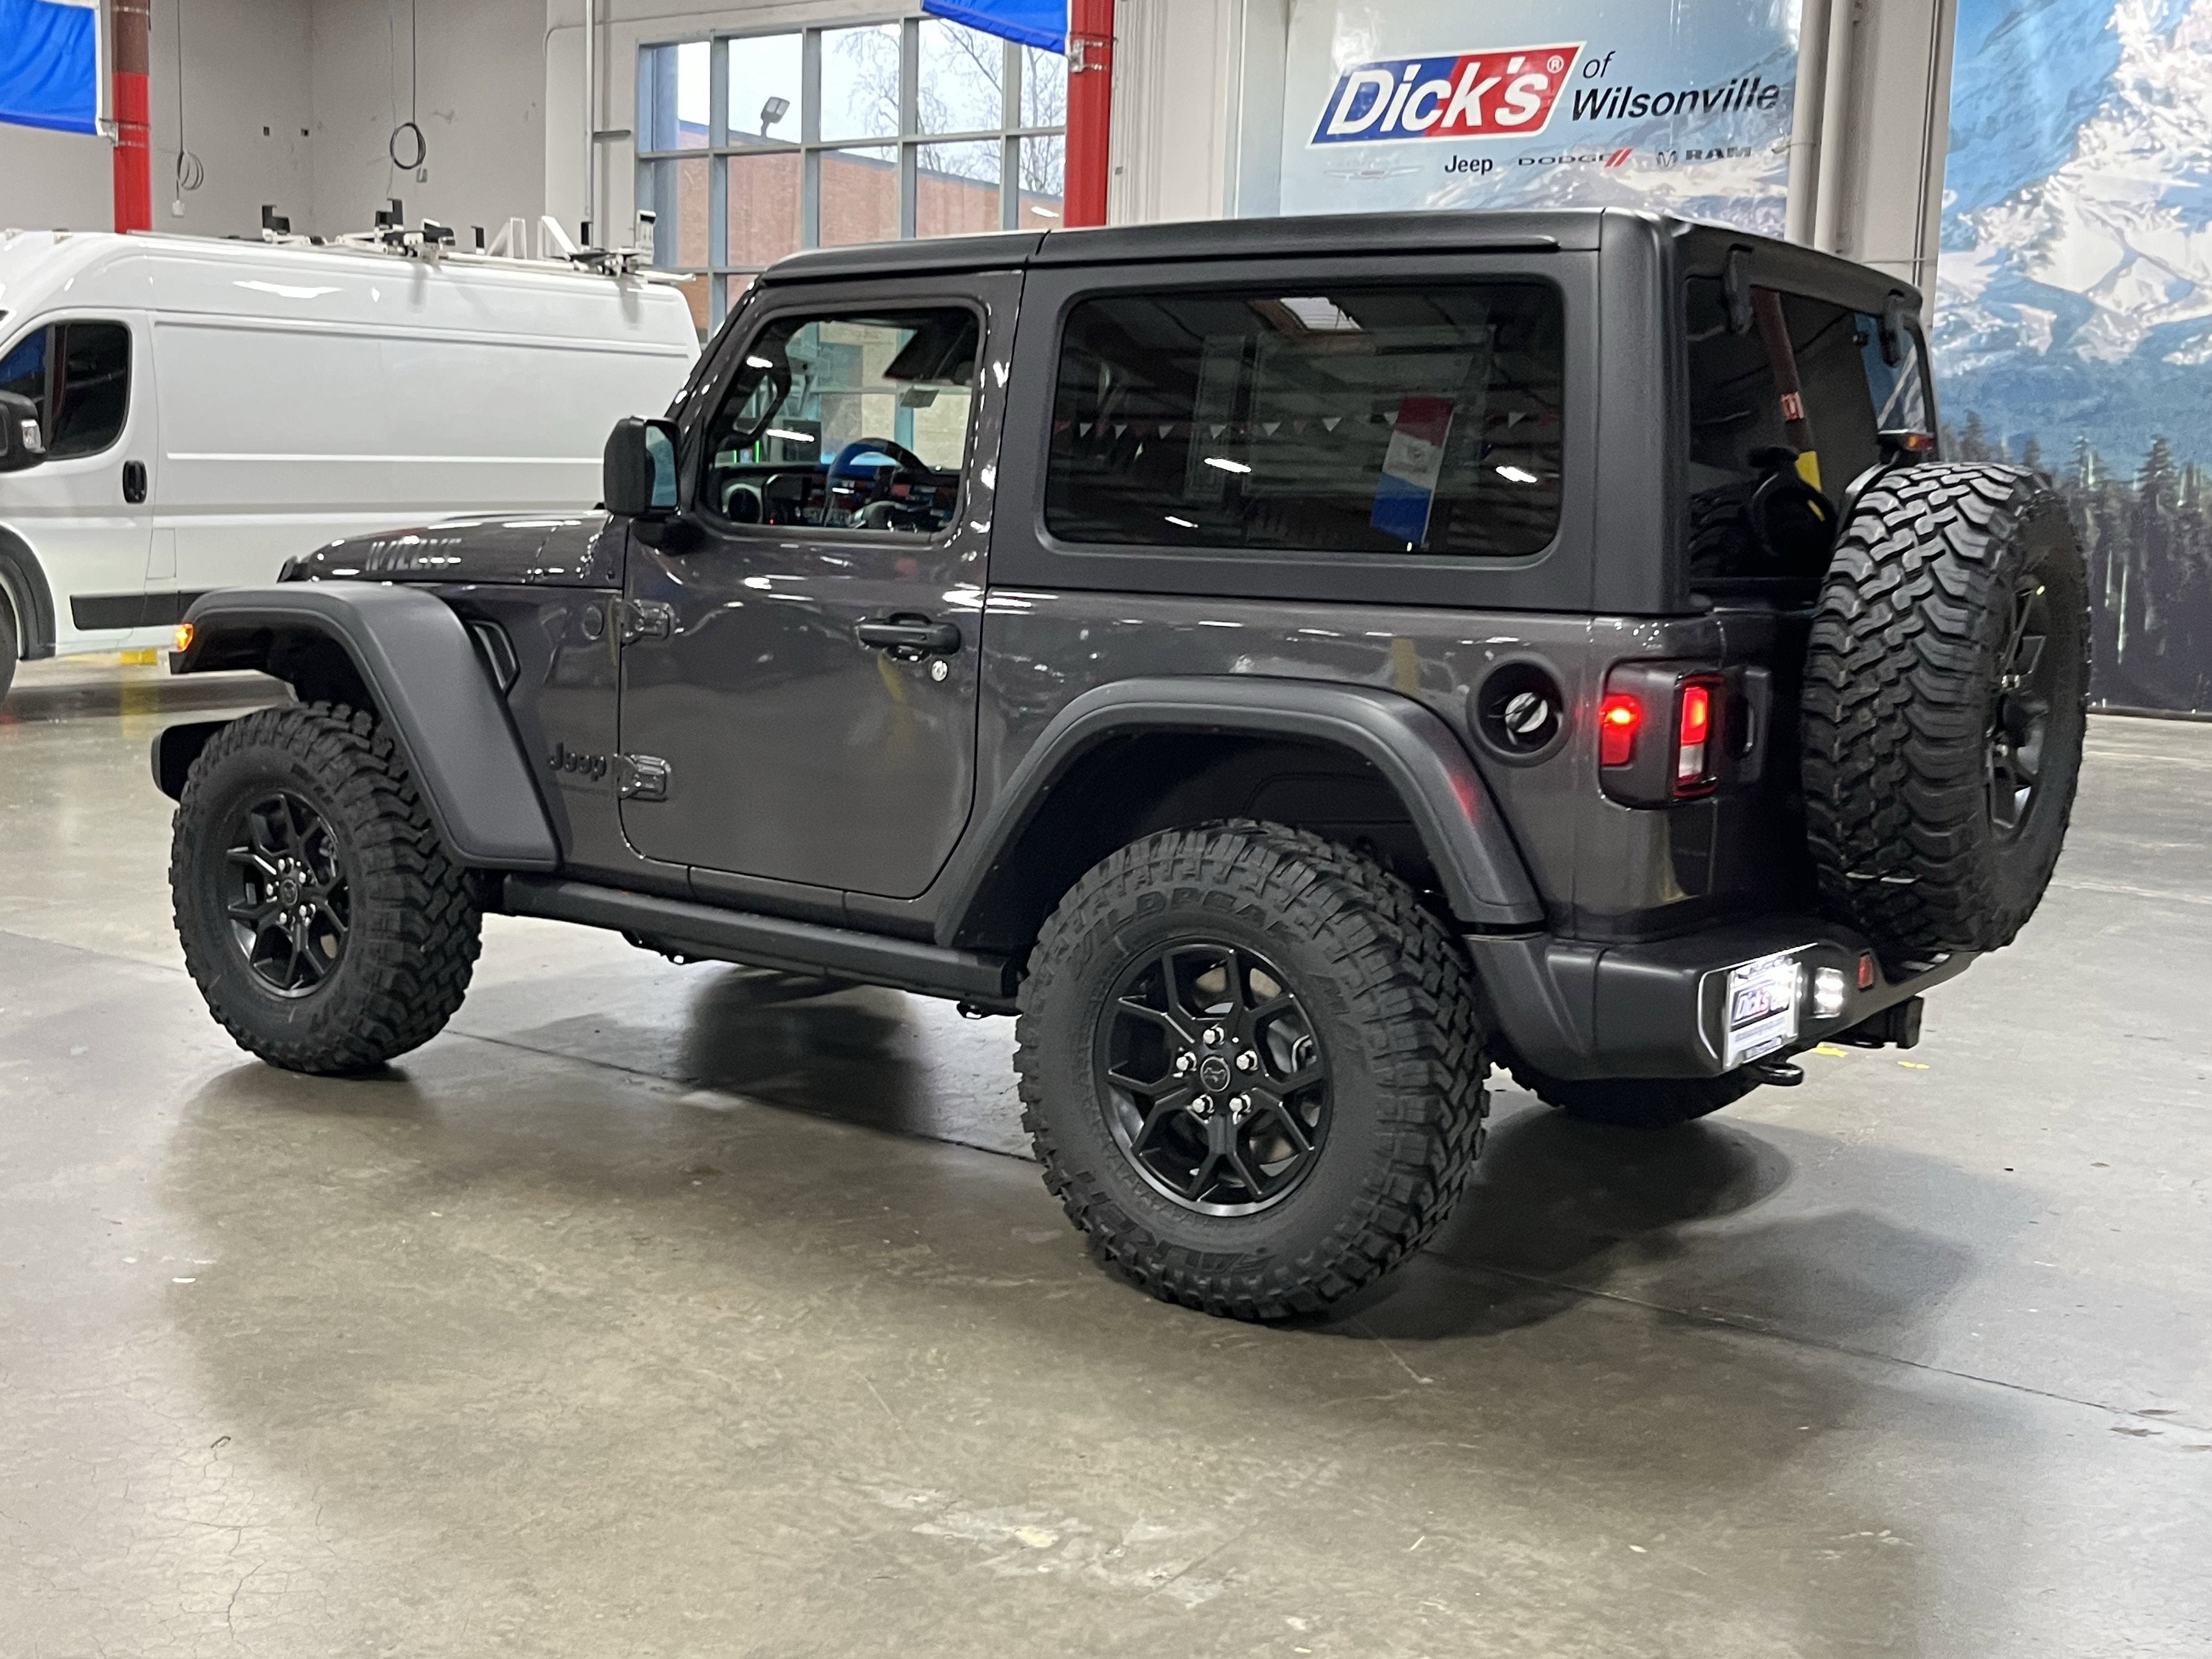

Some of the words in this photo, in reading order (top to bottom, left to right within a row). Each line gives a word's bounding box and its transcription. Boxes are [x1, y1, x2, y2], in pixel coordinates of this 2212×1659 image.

[1327, 57, 1548, 135] Dick's
[1583, 51, 1616, 78] of
[1572, 77, 1780, 121] Wilsonville
[1444, 155, 1493, 175] Jeep
[1685, 146, 1752, 160] RAM
[548, 742, 607, 782] Jeep
